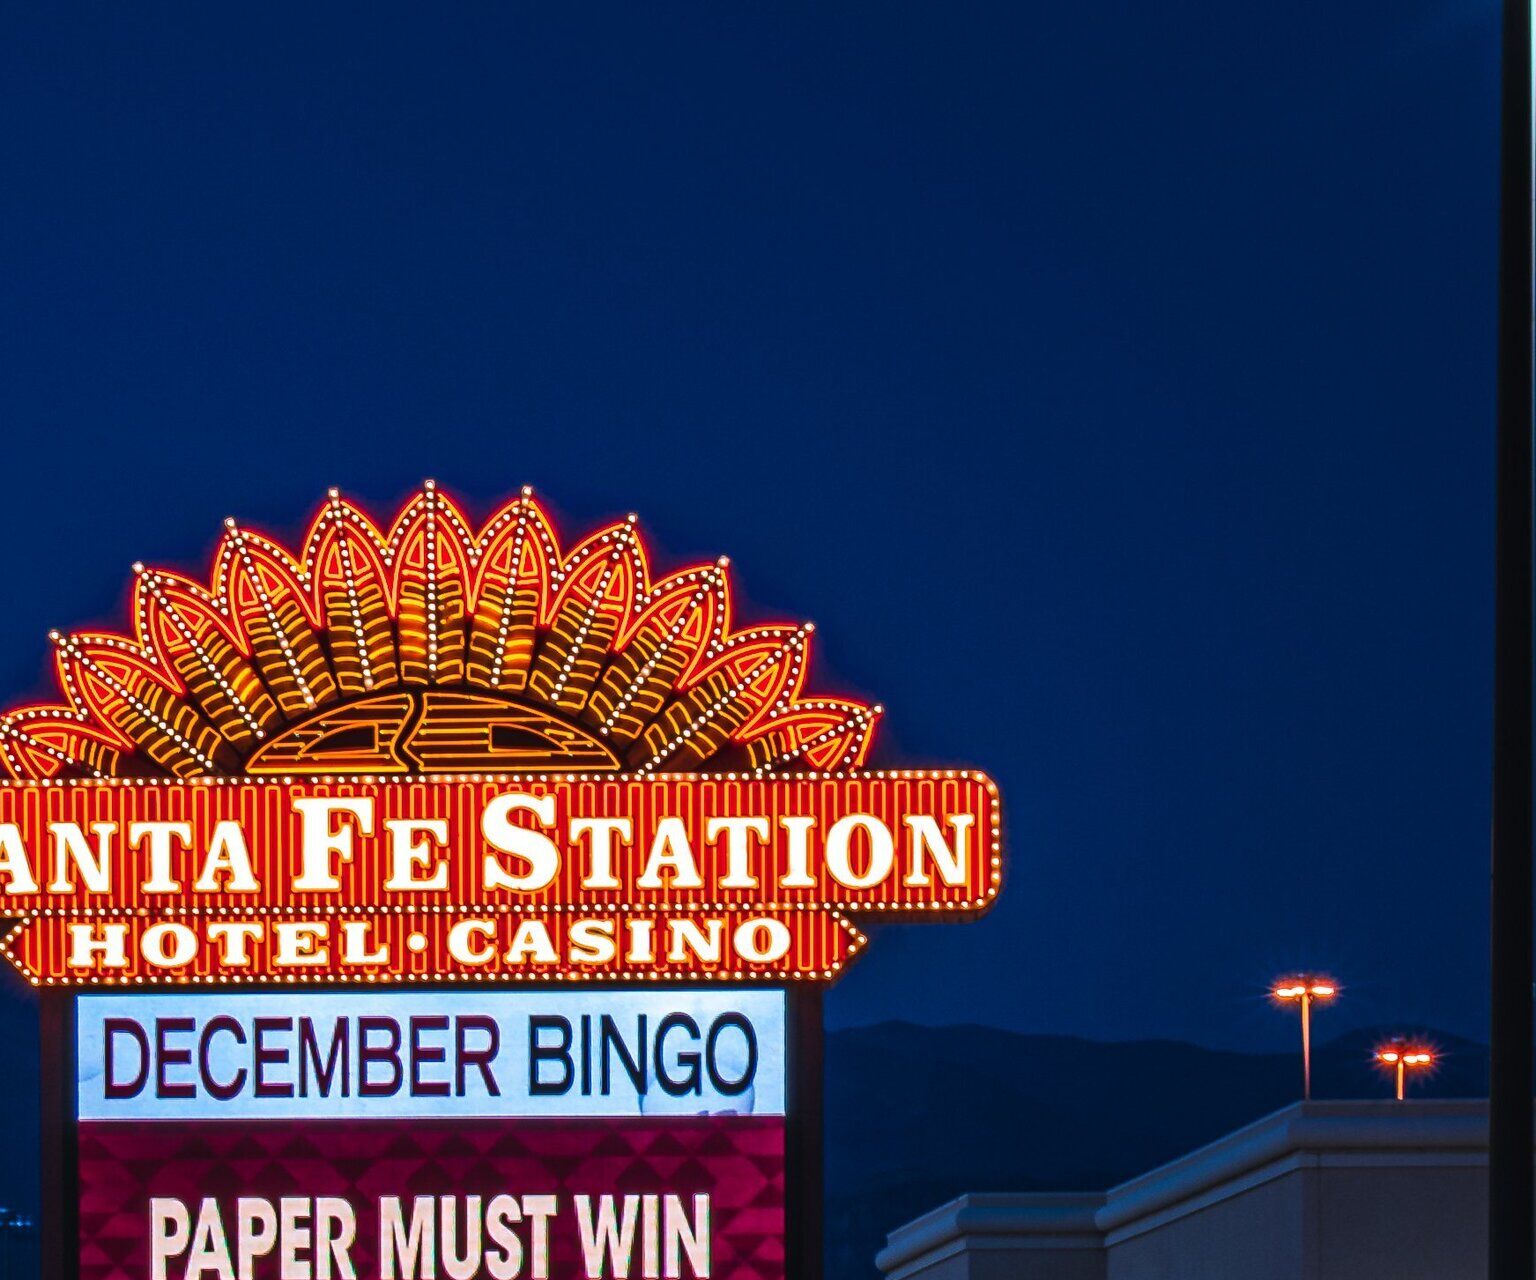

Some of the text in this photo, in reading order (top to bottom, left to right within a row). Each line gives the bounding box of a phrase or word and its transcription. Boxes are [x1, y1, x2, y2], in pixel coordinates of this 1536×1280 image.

[292, 796, 450, 893] FE
[481, 792, 975, 892] STATION
[67, 918, 791, 967] HOTEL CASINO
[103, 1013, 759, 1099] DECEMBER BINGO
[574, 1193, 711, 1280] WIN
